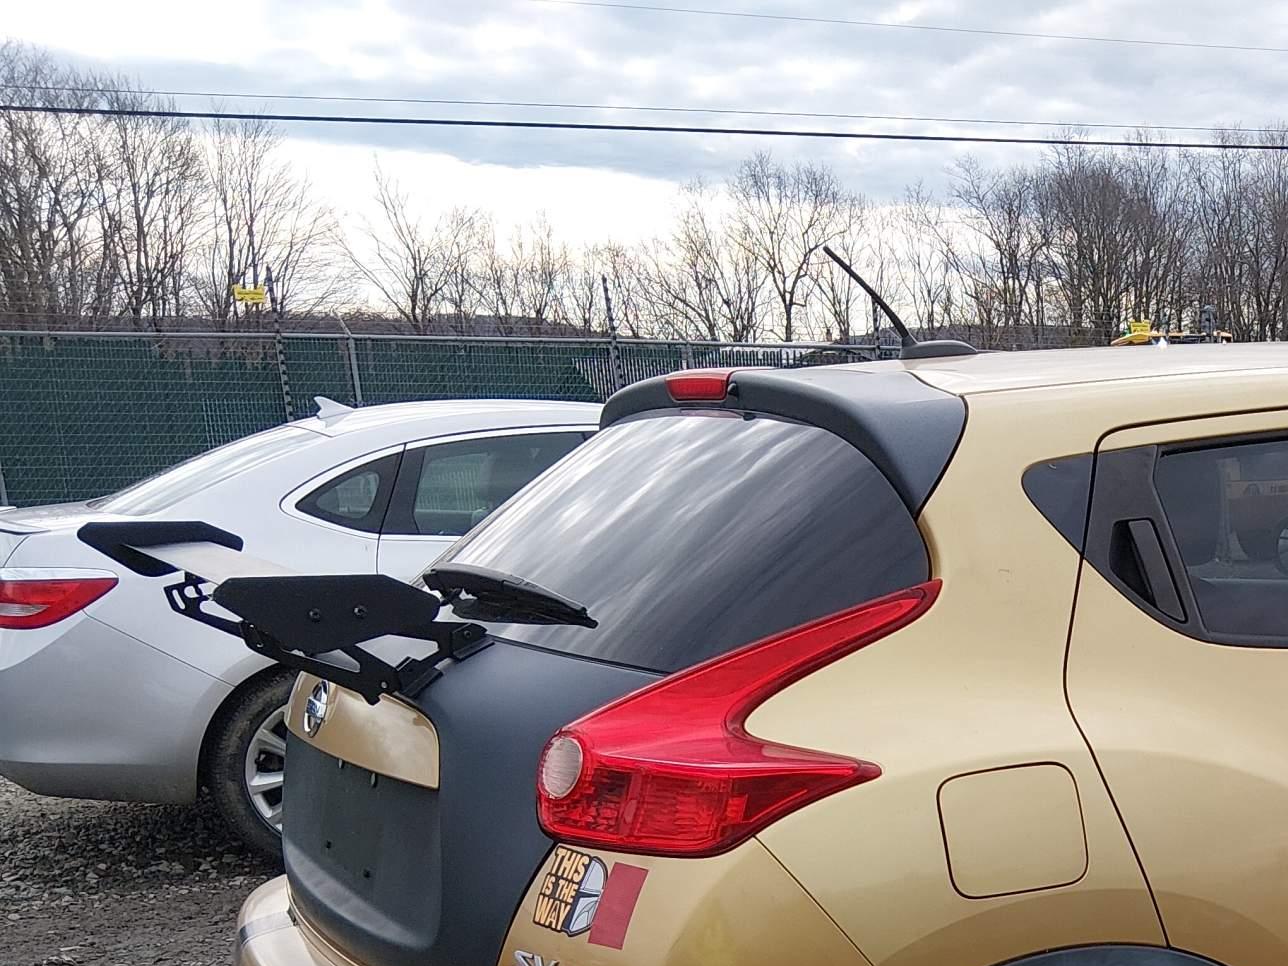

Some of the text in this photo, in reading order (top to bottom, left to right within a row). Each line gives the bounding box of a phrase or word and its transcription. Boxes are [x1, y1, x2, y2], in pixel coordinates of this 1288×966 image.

[551, 846, 590, 882] THIS
[541, 874, 580, 903] IS THE
[534, 895, 572, 930] WAY
